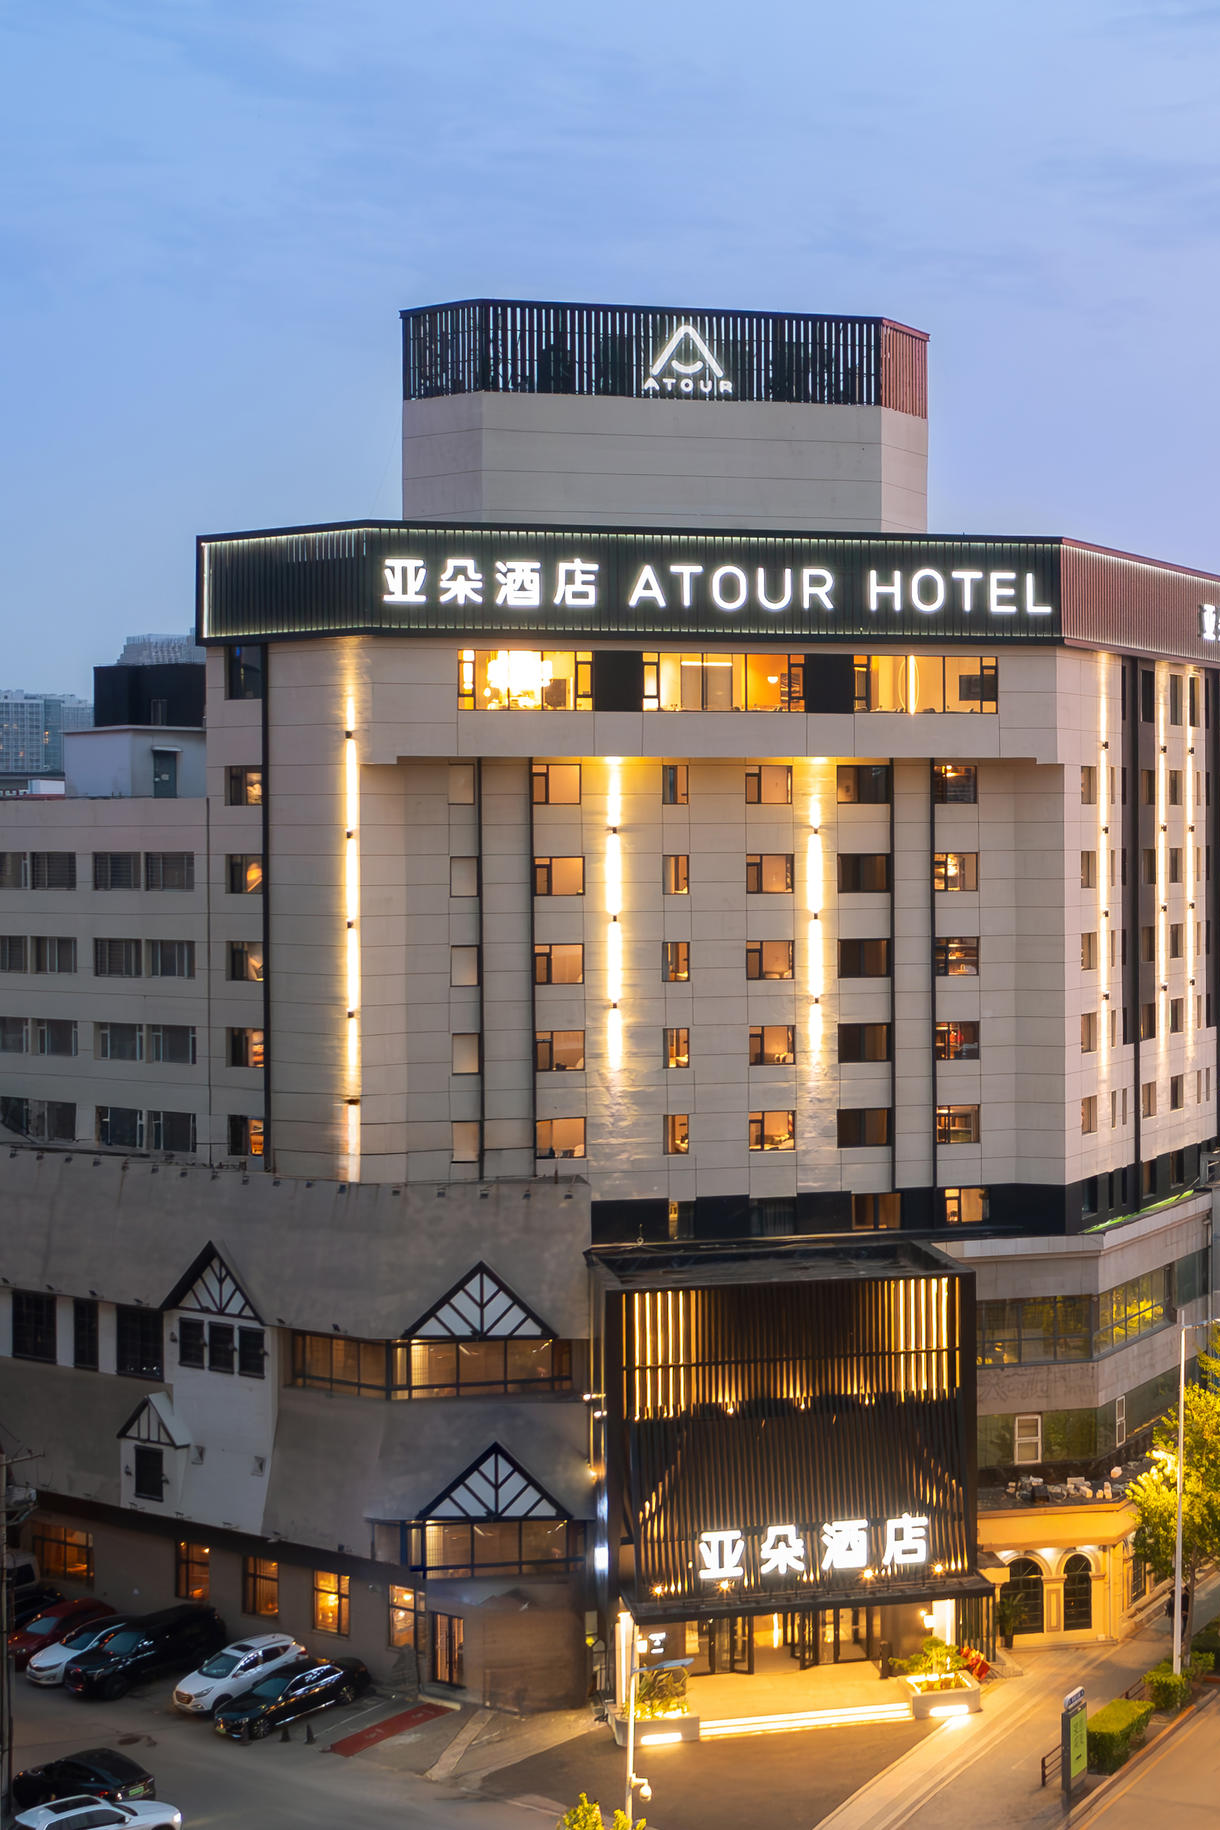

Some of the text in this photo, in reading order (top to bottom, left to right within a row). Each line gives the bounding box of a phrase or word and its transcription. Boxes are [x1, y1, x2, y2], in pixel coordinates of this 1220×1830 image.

[644, 377, 733, 394] ATOUR
[383, 557, 1052, 614] 亚朵酒店 ATOUR HOTEL
[699, 1513, 929, 1579] 亚朵酒店
